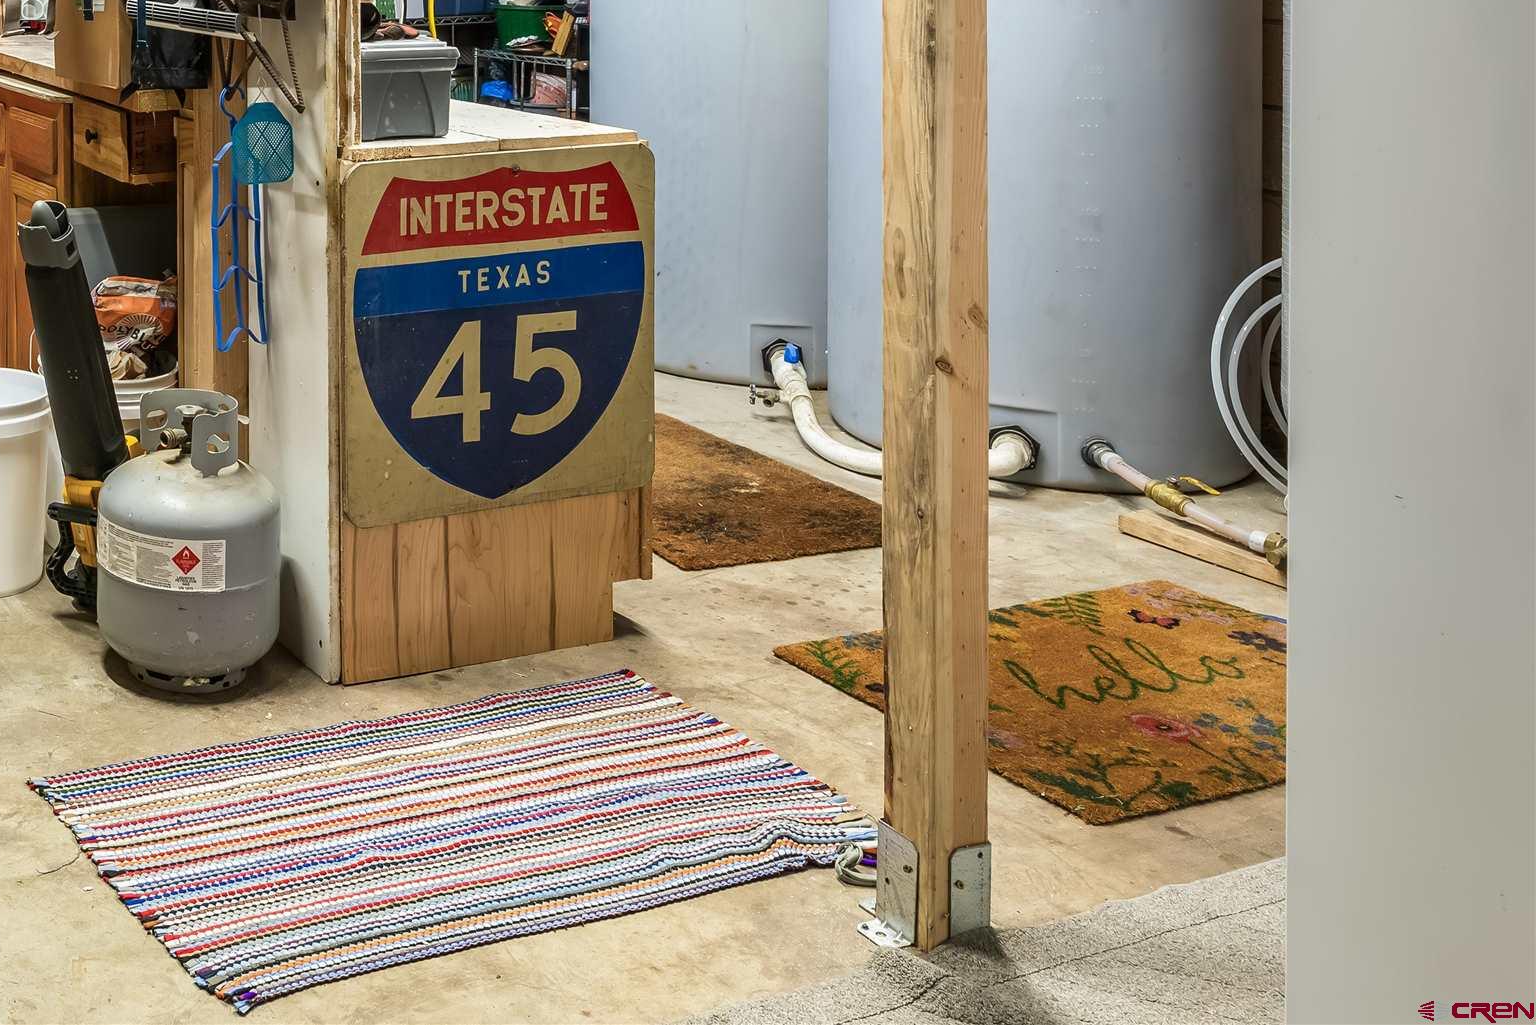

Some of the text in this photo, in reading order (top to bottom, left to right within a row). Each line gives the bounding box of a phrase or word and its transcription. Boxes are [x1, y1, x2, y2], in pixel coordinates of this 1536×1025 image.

[399, 182, 609, 237] INTERSTATE
[457, 260, 552, 294] TEXAS
[410, 309, 583, 444] 45
[1003, 637, 1246, 711] hello
